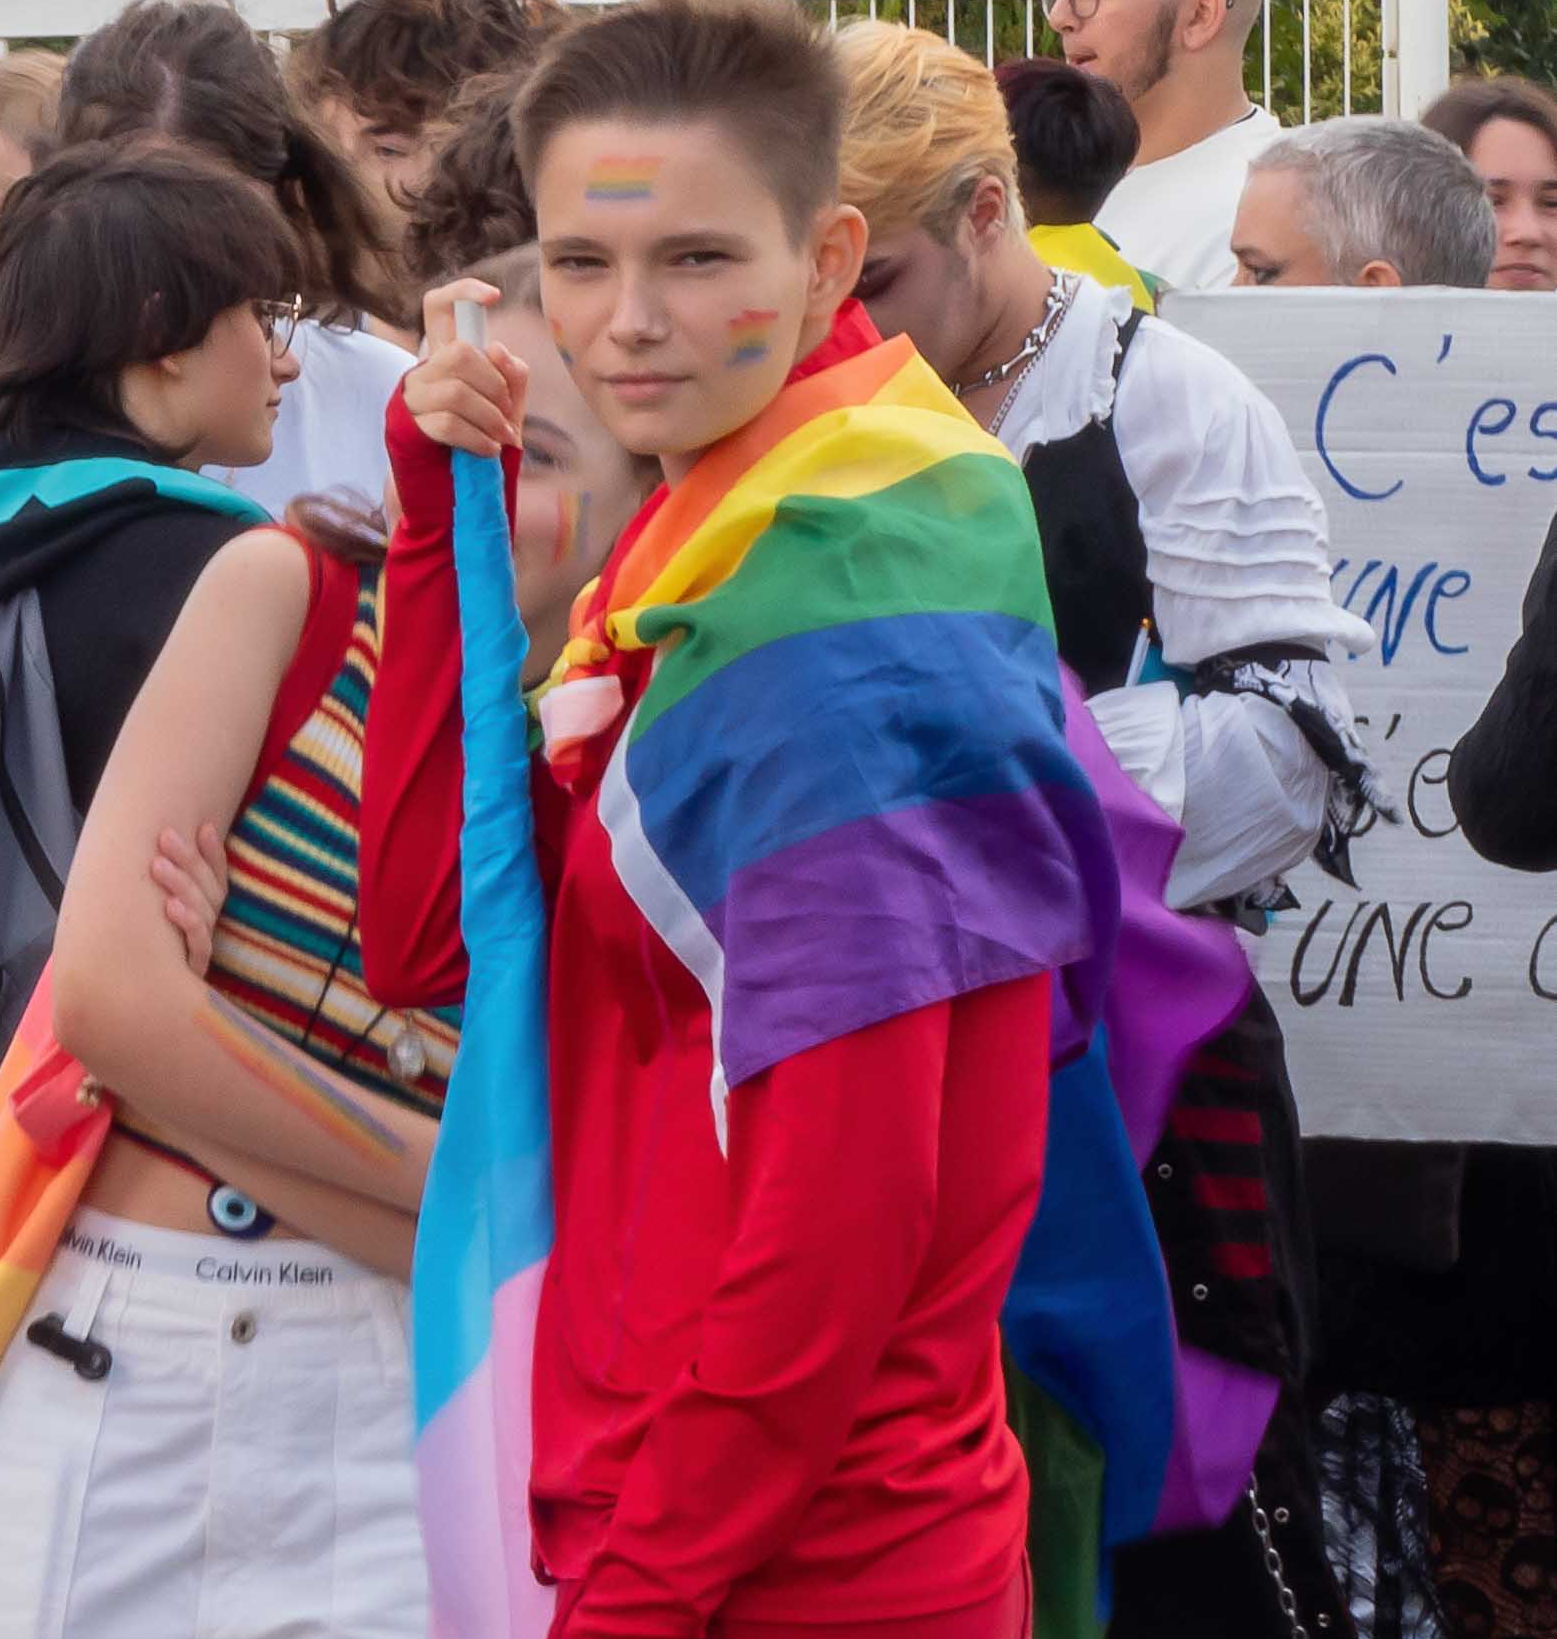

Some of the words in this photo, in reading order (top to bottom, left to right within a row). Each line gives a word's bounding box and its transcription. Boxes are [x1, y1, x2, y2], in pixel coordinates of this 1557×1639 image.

[96, 1236, 142, 1270] Klein
[195, 1256, 272, 1284] Calvin
[278, 1260, 333, 1286] Klein
